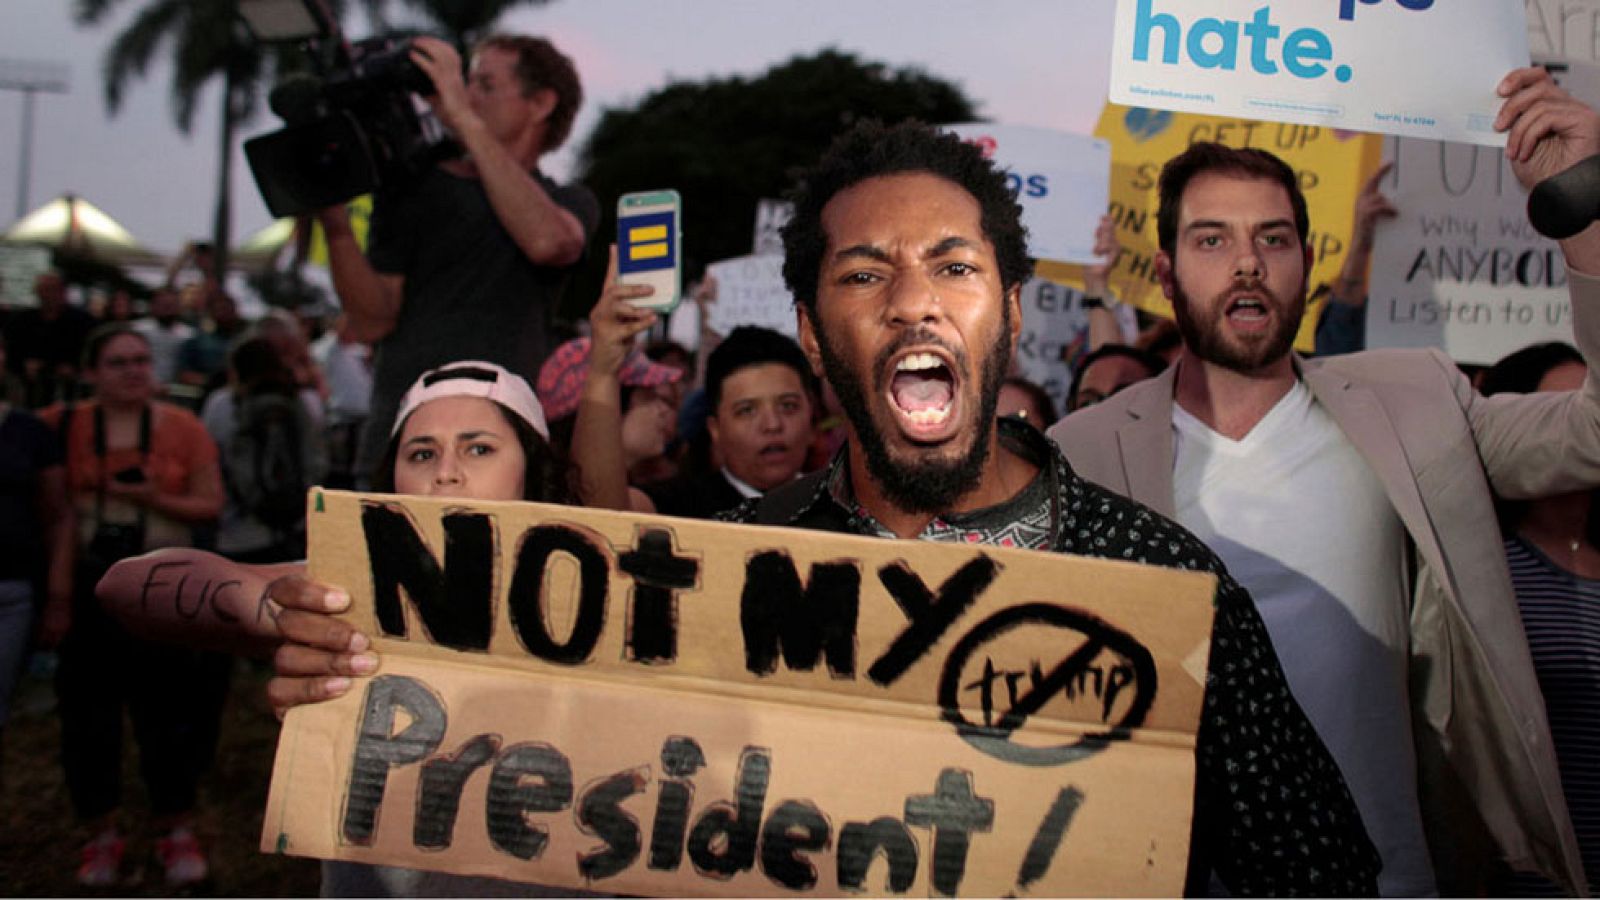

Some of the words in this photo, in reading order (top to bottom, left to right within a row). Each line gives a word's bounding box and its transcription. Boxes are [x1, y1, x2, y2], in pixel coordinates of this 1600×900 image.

[1132, 0, 1353, 83] hate.
[1276, 122, 1320, 149] UP
[1500, 298, 1534, 325] to
[740, 553, 1004, 687] MY
